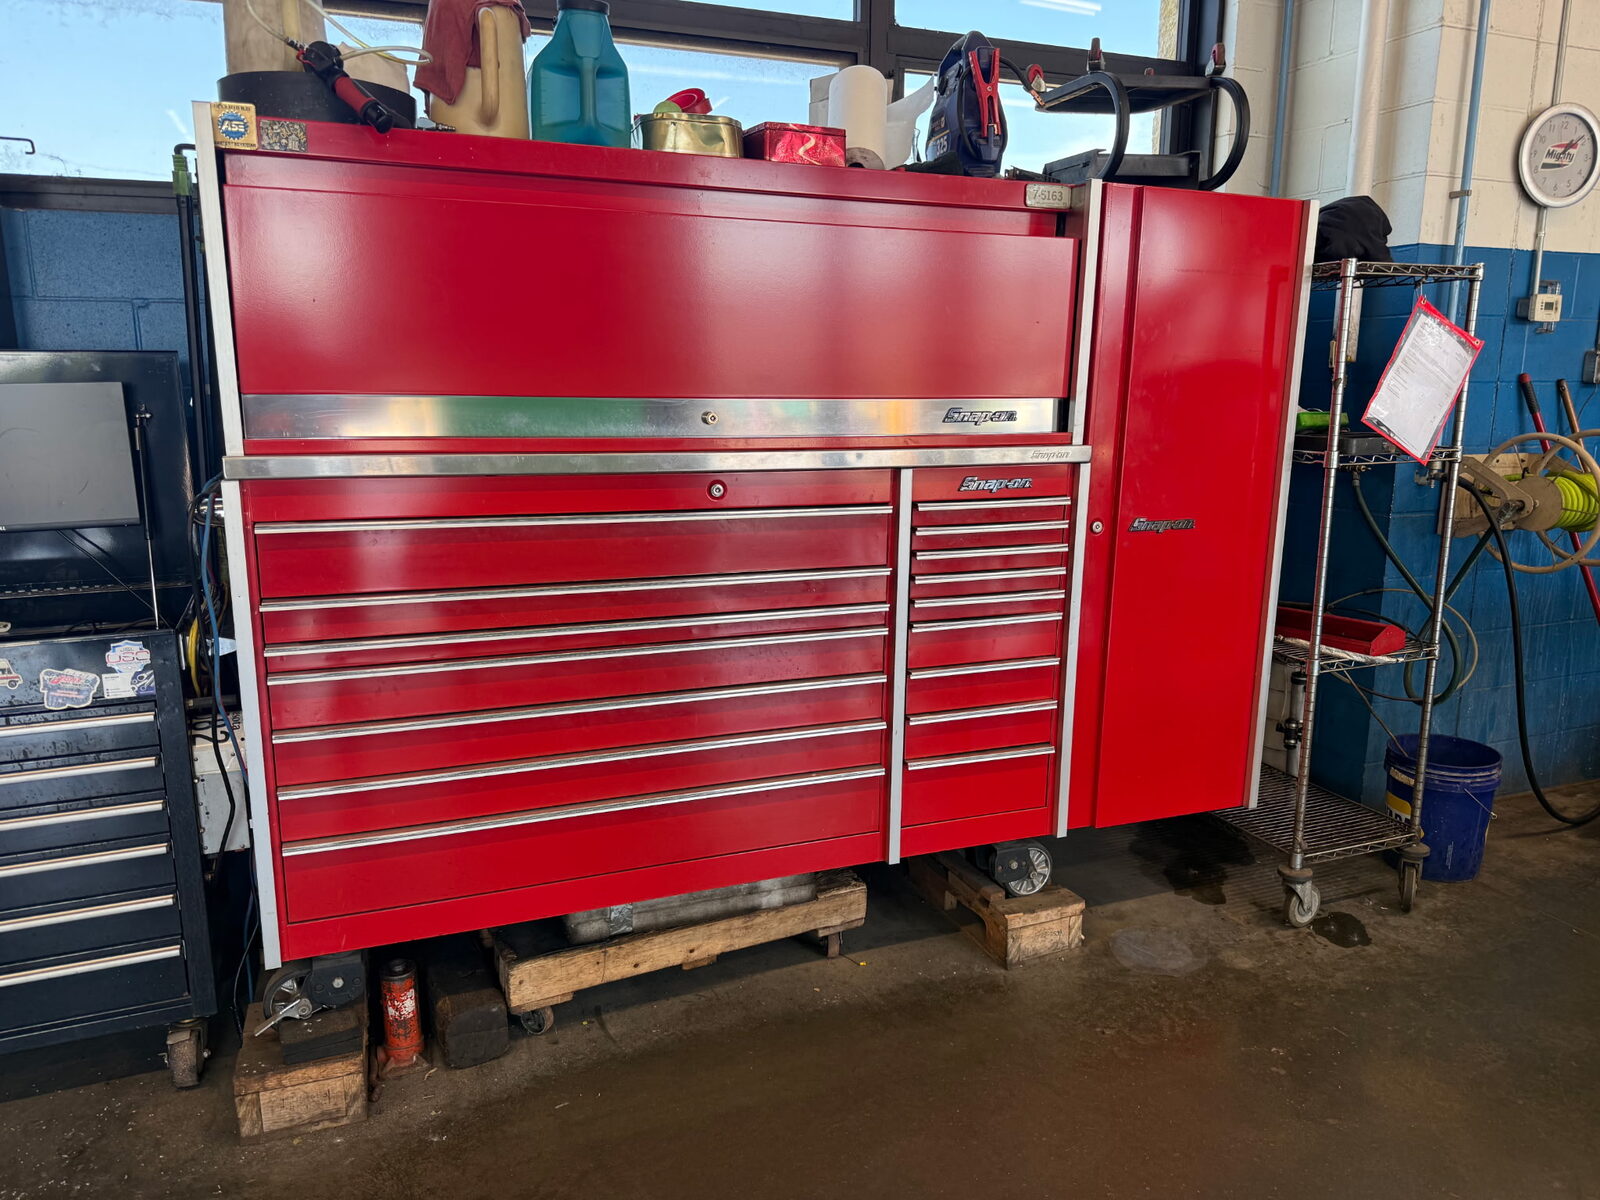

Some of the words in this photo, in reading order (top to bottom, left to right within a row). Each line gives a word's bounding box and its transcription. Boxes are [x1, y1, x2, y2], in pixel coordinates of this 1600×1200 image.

[222, 120, 245, 132] ASE
[1560, 120, 1569, 130] 12
[942, 407, 1018, 426] Snap-on
[959, 476, 1033, 493] Snap-on
[1129, 517, 1196, 534] Snap-on
